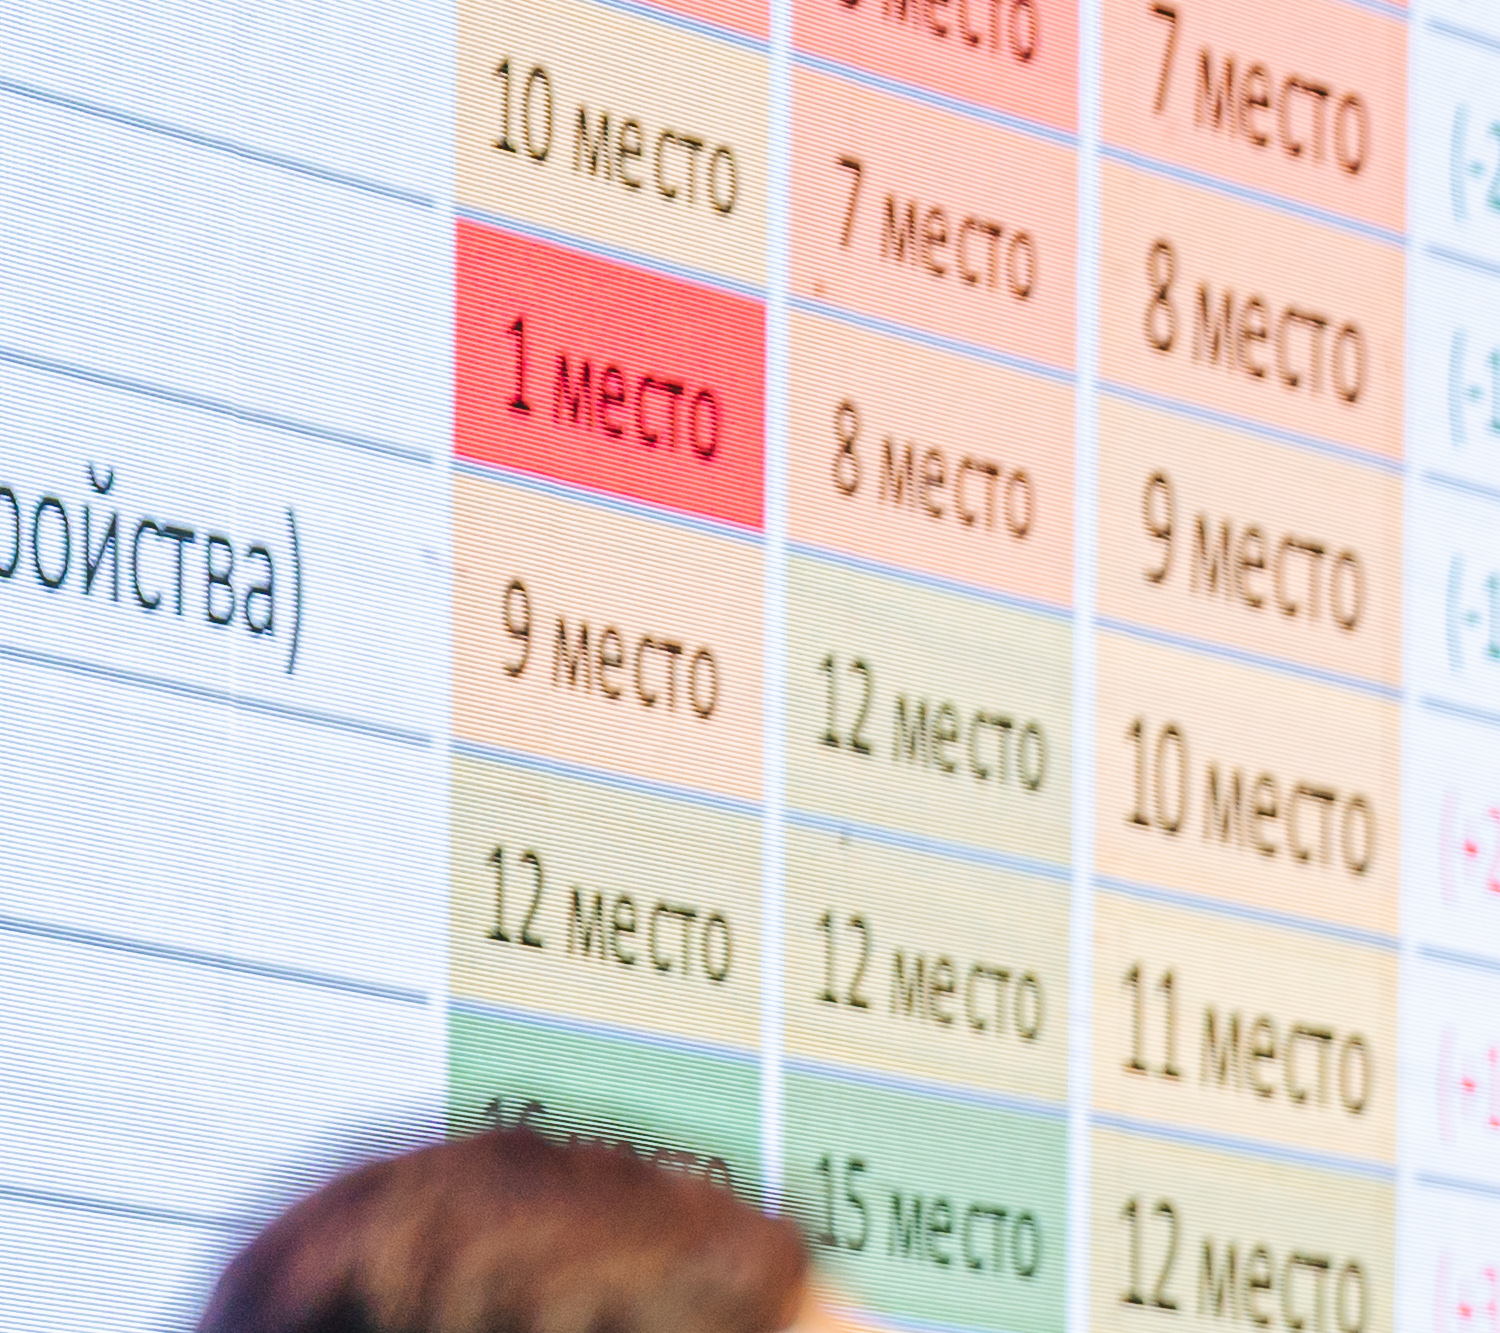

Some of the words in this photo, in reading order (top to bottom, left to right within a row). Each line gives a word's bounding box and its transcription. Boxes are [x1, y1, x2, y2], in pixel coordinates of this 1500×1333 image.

[492, 56, 555, 166] 10
[573, 104, 740, 219] место
[1148, 3, 1184, 112] 7
[1196, 48, 1367, 179] место
[834, 152, 867, 248] 7
[881, 193, 1036, 304] место
[504, 314, 535, 418] 1
[554, 352, 721, 464] место
[1147, 237, 1177, 356] 8
[1194, 282, 1364, 408] место
[832, 397, 862, 500] 8
[879, 437, 1033, 542] место
[1143, 469, 1177, 588] 9
[1192, 513, 1362, 635] место
[501, 576, 535, 682] 9
[552, 616, 720, 723] место
[818, 654, 875, 759] 12
[892, 694, 1048, 795] место
[1126, 717, 1186, 839] 10
[1204, 764, 1374, 879] место
[485, 844, 546, 952] 12
[567, 885, 733, 987] место
[816, 910, 872, 1013] 12
[890, 949, 1043, 1045] место
[1122, 962, 1184, 1083] 11
[1201, 1006, 1372, 1118] место
[813, 1155, 868, 1256] 15
[888, 1190, 1042, 1282] место
[1120, 1197, 1181, 1315] 12
